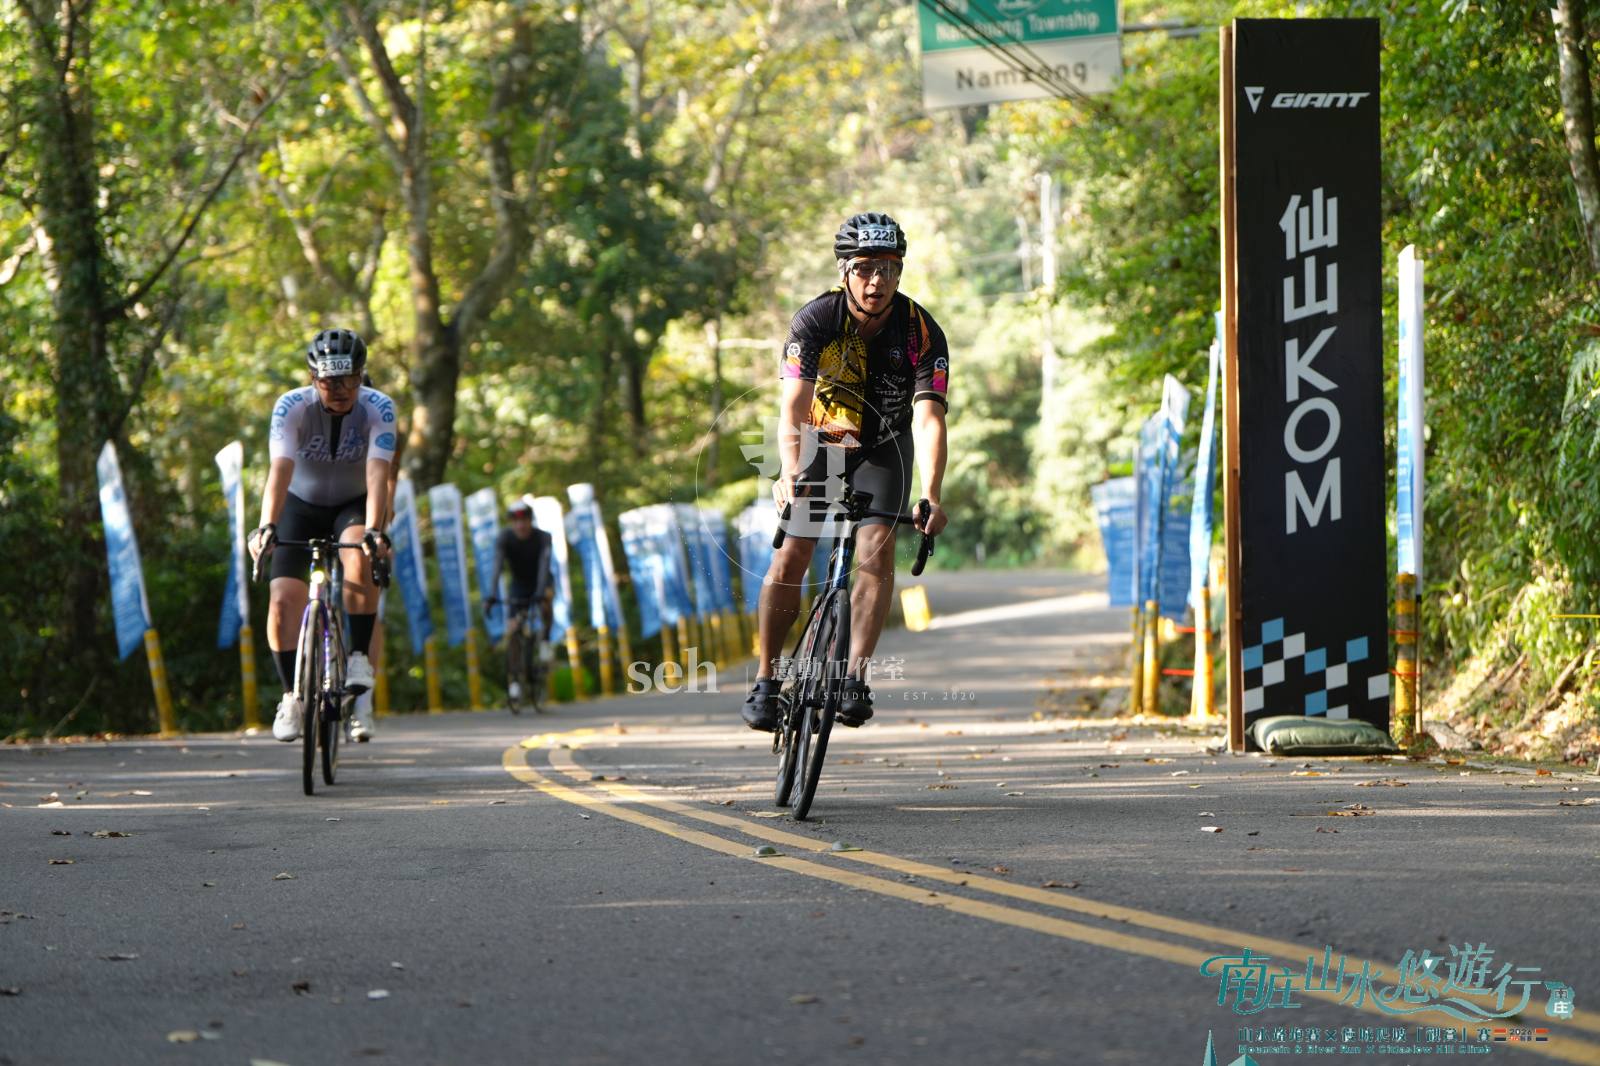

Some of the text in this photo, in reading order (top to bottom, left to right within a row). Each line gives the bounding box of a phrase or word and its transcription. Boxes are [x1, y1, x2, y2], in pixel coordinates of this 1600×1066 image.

[1027, 11, 1099, 33] Township
[1271, 92, 1371, 108] GIANT
[367, 392, 395, 423] bike
